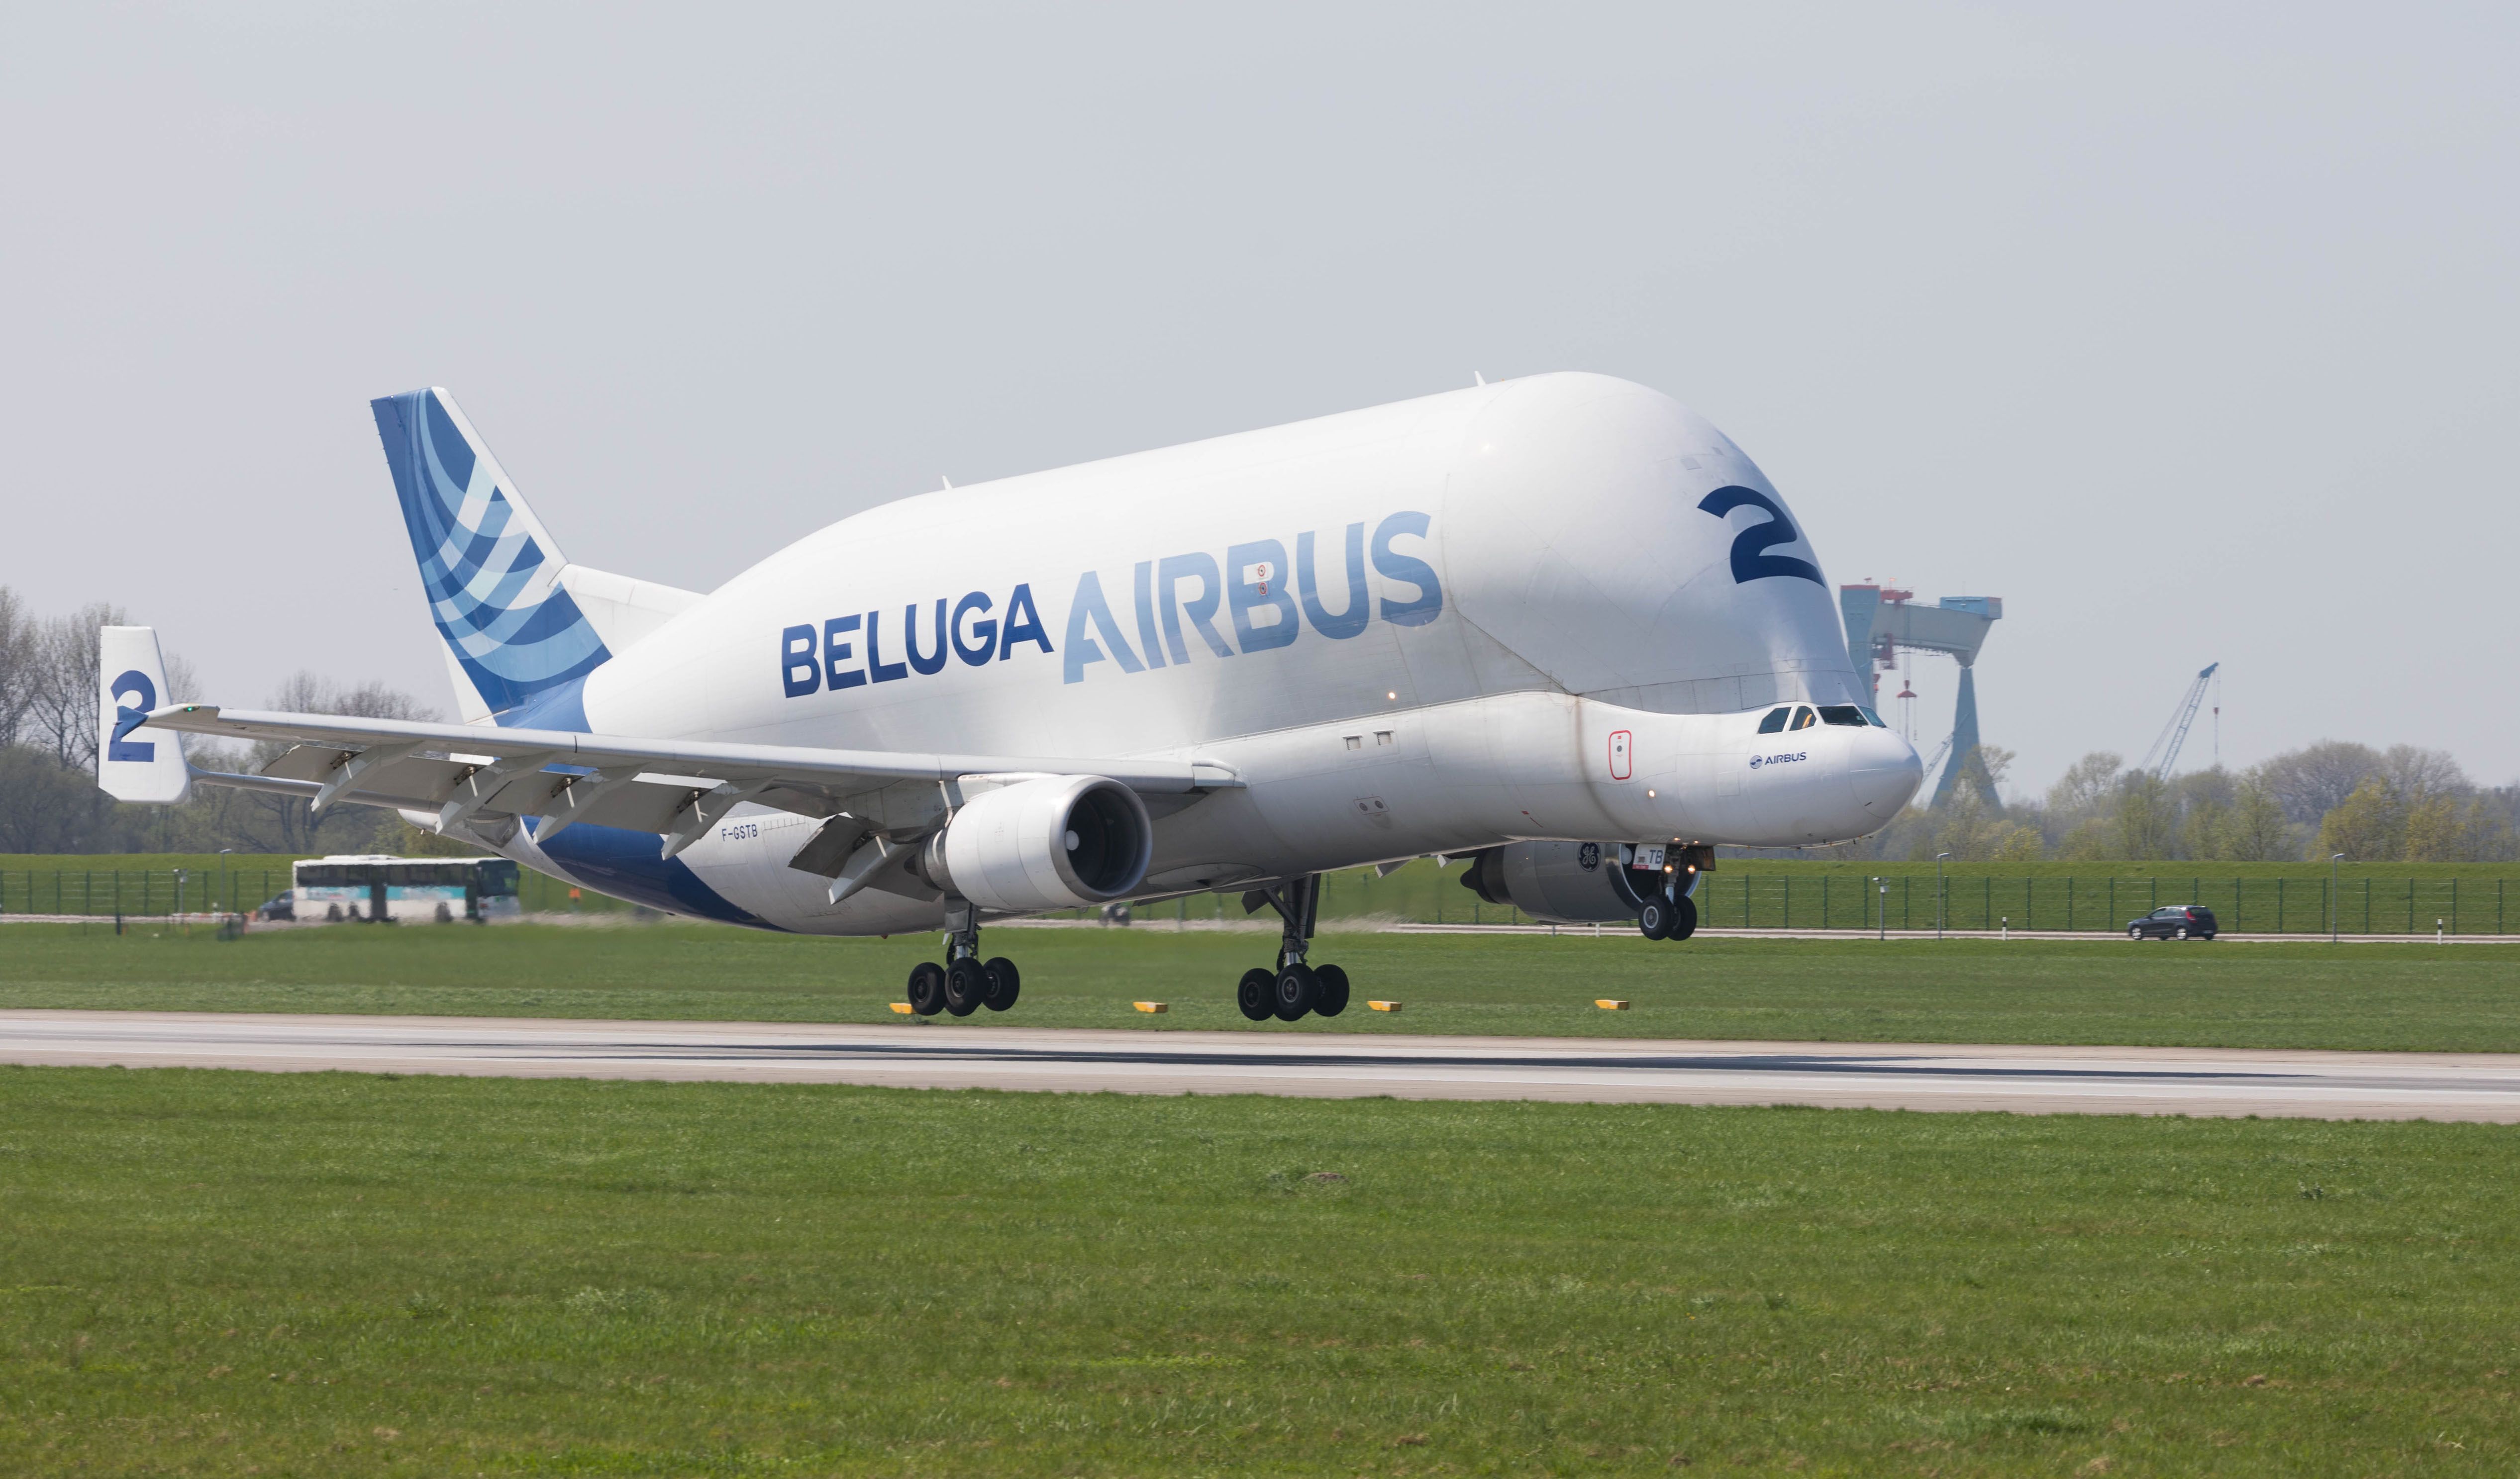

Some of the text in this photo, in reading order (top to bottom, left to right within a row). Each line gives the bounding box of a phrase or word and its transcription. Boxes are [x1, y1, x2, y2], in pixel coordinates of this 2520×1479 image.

[1697, 486, 1827, 589] 2
[783, 511, 1443, 698] BELUGA AIRBUS
[108, 670, 156, 762] 2
[1765, 752, 1807, 765] AIRBUS
[722, 824, 757, 842] F-GSTB
[1649, 849, 1663, 864] TB
